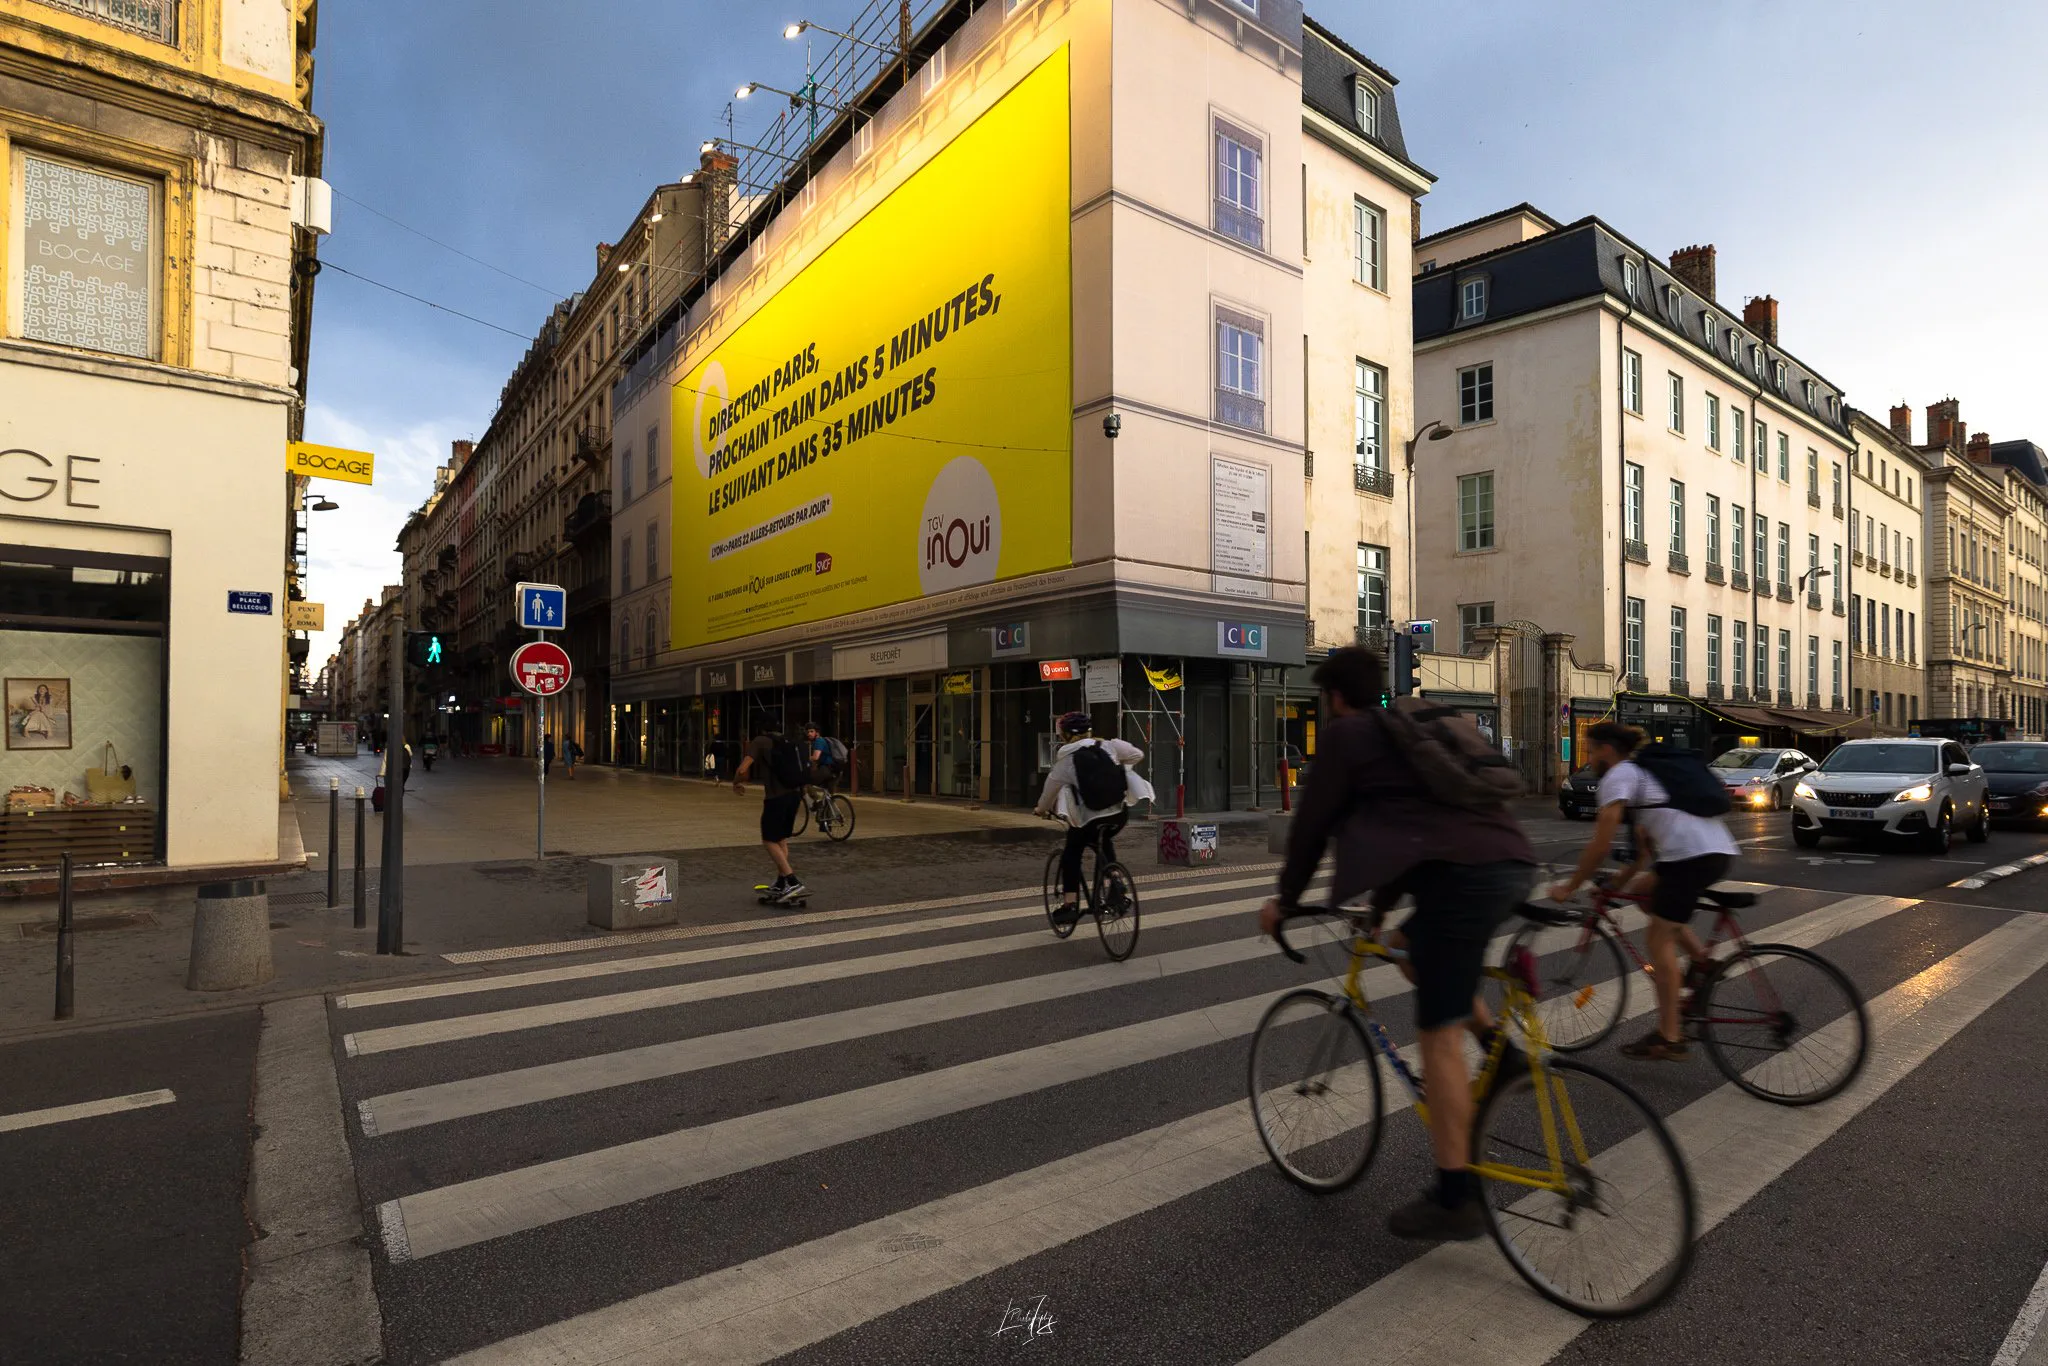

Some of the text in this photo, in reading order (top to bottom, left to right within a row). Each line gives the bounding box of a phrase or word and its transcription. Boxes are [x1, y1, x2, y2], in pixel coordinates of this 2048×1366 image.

[38, 239, 135, 274] BOCAGE
[708, 273, 1002, 479] PROCHAIN TRAIN DANS 5 MINUTES,
[708, 342, 820, 442] DIRECTION PARIS,
[708, 366, 937, 516] LE SUIVANT DANS 35 MINUTES
[296, 452, 371, 476] BOCAGE
[742, 532, 750, 546] 22
[796, 508, 808, 526] PAR
[928, 514, 944, 532] TGV
[766, 576, 774, 586] SUR
[774, 570, 790, 582] LEQUEL
[790, 563, 812, 578] COMPTER
[816, 558, 832, 574] SNCF
[998, 628, 1022, 646] CIC
[1228, 628, 1258, 646] CIC
[1413, 625, 1428, 633] CIC
[870, 647, 900, 662] BLEUFORÊT
